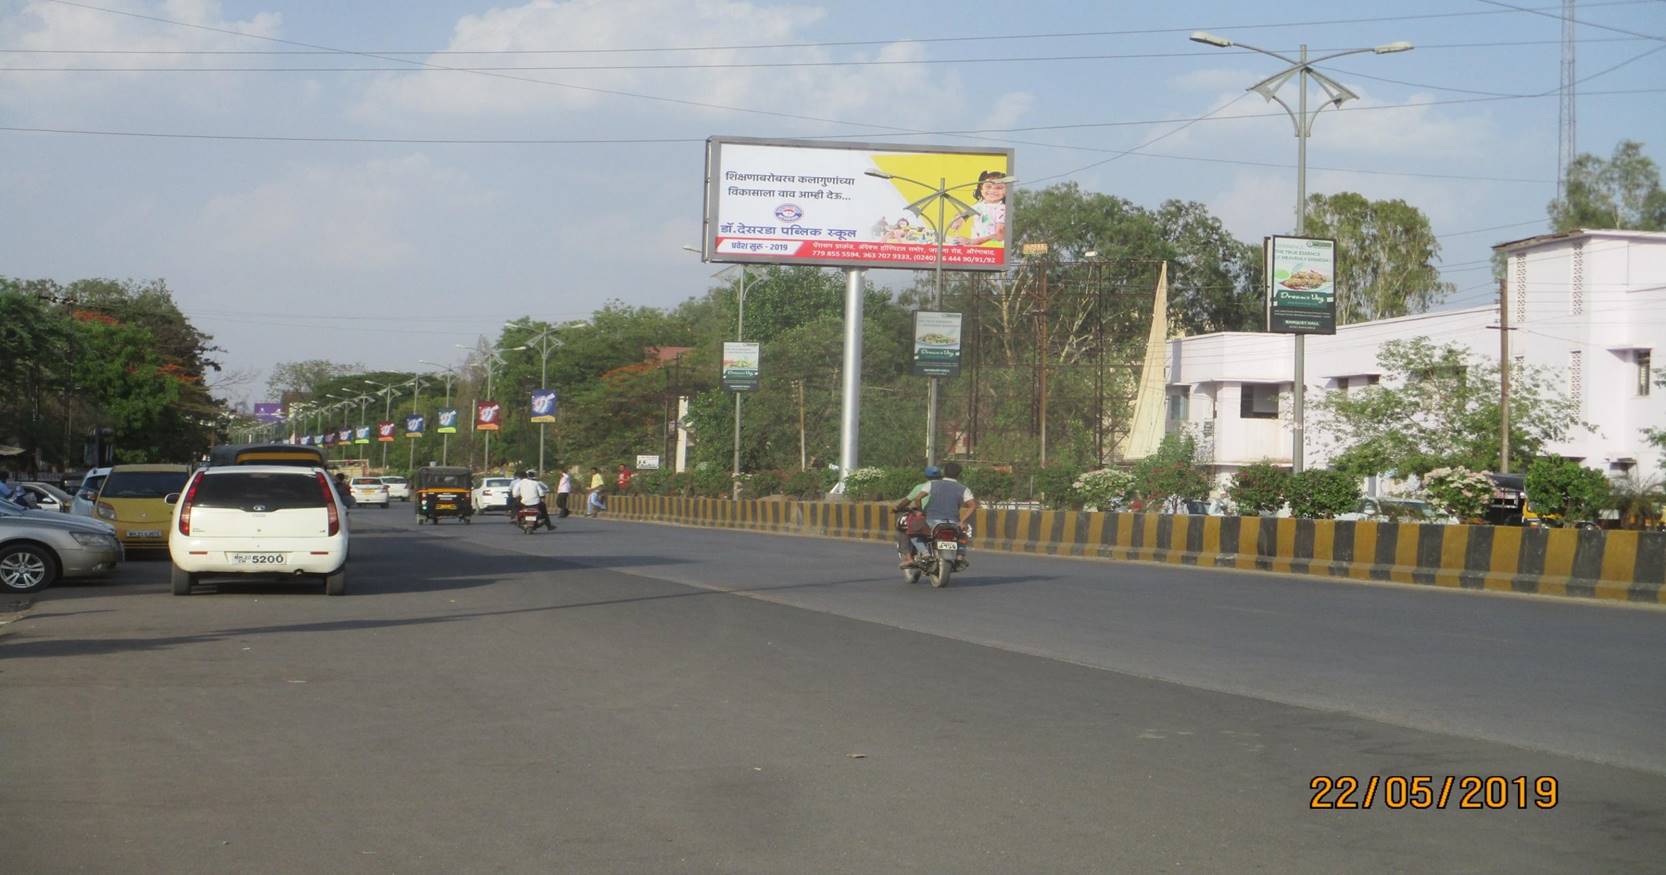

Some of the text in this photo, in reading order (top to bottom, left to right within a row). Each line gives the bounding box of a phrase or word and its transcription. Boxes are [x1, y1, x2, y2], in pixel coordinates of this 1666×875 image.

[726, 171, 855, 187] शिक्षणाबरोबरच कलागुणांच्या
[728, 186, 775, 197] विकासाला
[778, 189, 795, 198] वाव
[798, 189, 823, 199] आम्ही
[781, 224, 822, 236] पब्लिक
[828, 228, 857, 240] स्कूल
[731, 242, 748, 250] प्रवेश
[913, 254, 936, 262] (0240)
[252, 554, 284, 564] 5200
